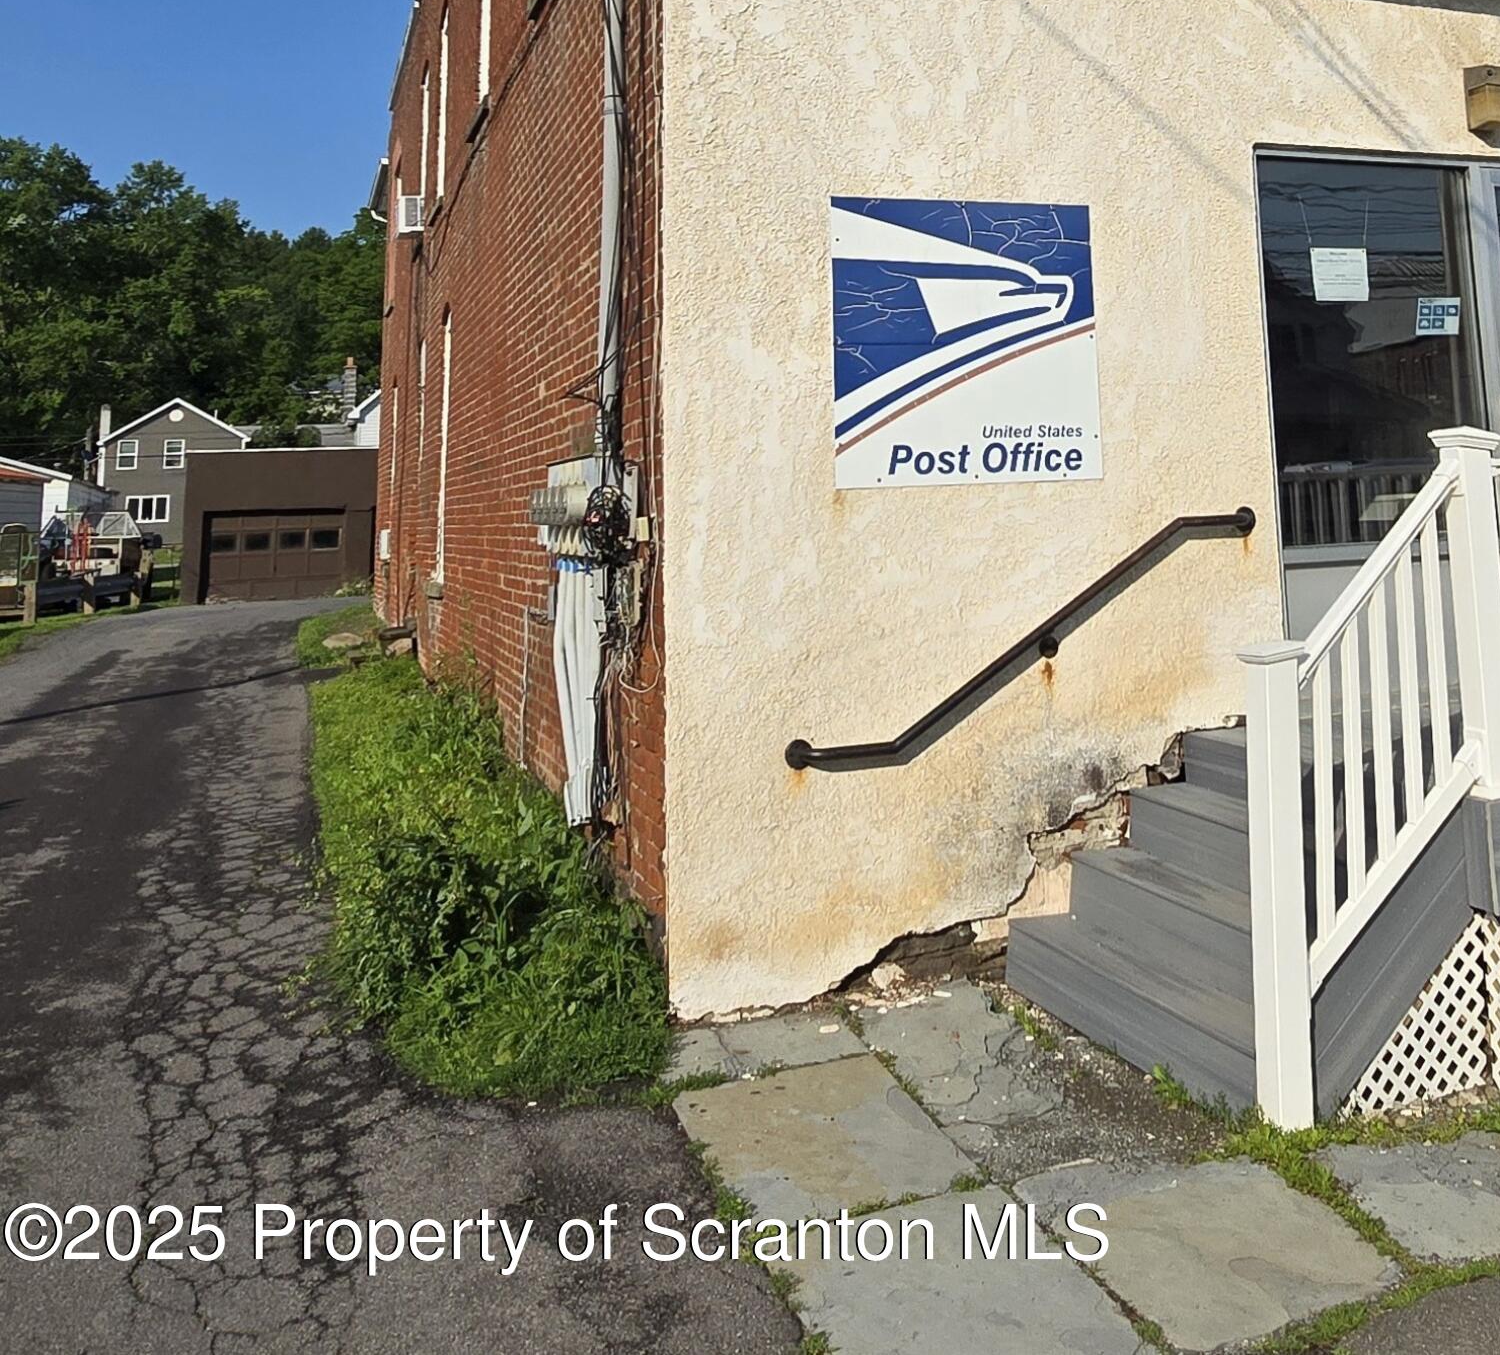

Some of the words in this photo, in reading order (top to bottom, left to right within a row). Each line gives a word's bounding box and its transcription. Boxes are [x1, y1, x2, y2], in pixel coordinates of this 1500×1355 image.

[982, 425, 1033, 439] United
[1037, 425, 1083, 438] States
[888, 445, 970, 475] Post
[982, 442, 1083, 473] Office
